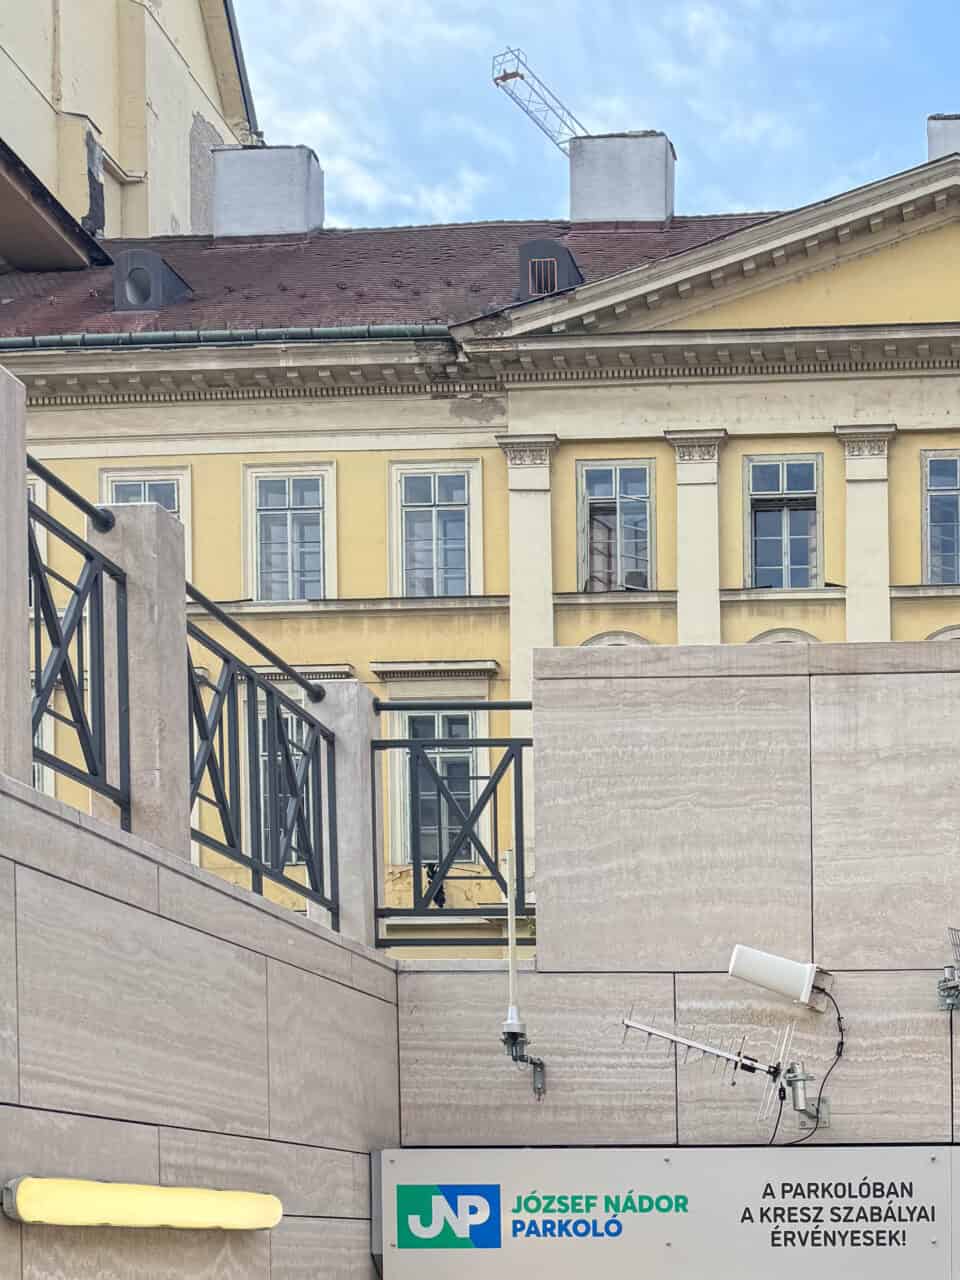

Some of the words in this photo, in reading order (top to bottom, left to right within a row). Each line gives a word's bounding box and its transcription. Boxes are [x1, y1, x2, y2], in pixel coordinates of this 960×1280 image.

[762, 1183, 776, 1200] A
[782, 1177, 914, 1199] PARKOLÓBAN
[512, 1191, 598, 1214] JÓZSEF
[604, 1190, 689, 1214] NÁDOR
[741, 1207, 755, 1224] A
[760, 1206, 825, 1224] KRESZ
[830, 1200, 936, 1223] SZABÁLYAI
[408, 1195, 490, 1239] JNP
[512, 1214, 623, 1238] PARKOLÓ
[771, 1225, 907, 1247] ÉRVÉNYESEK!
